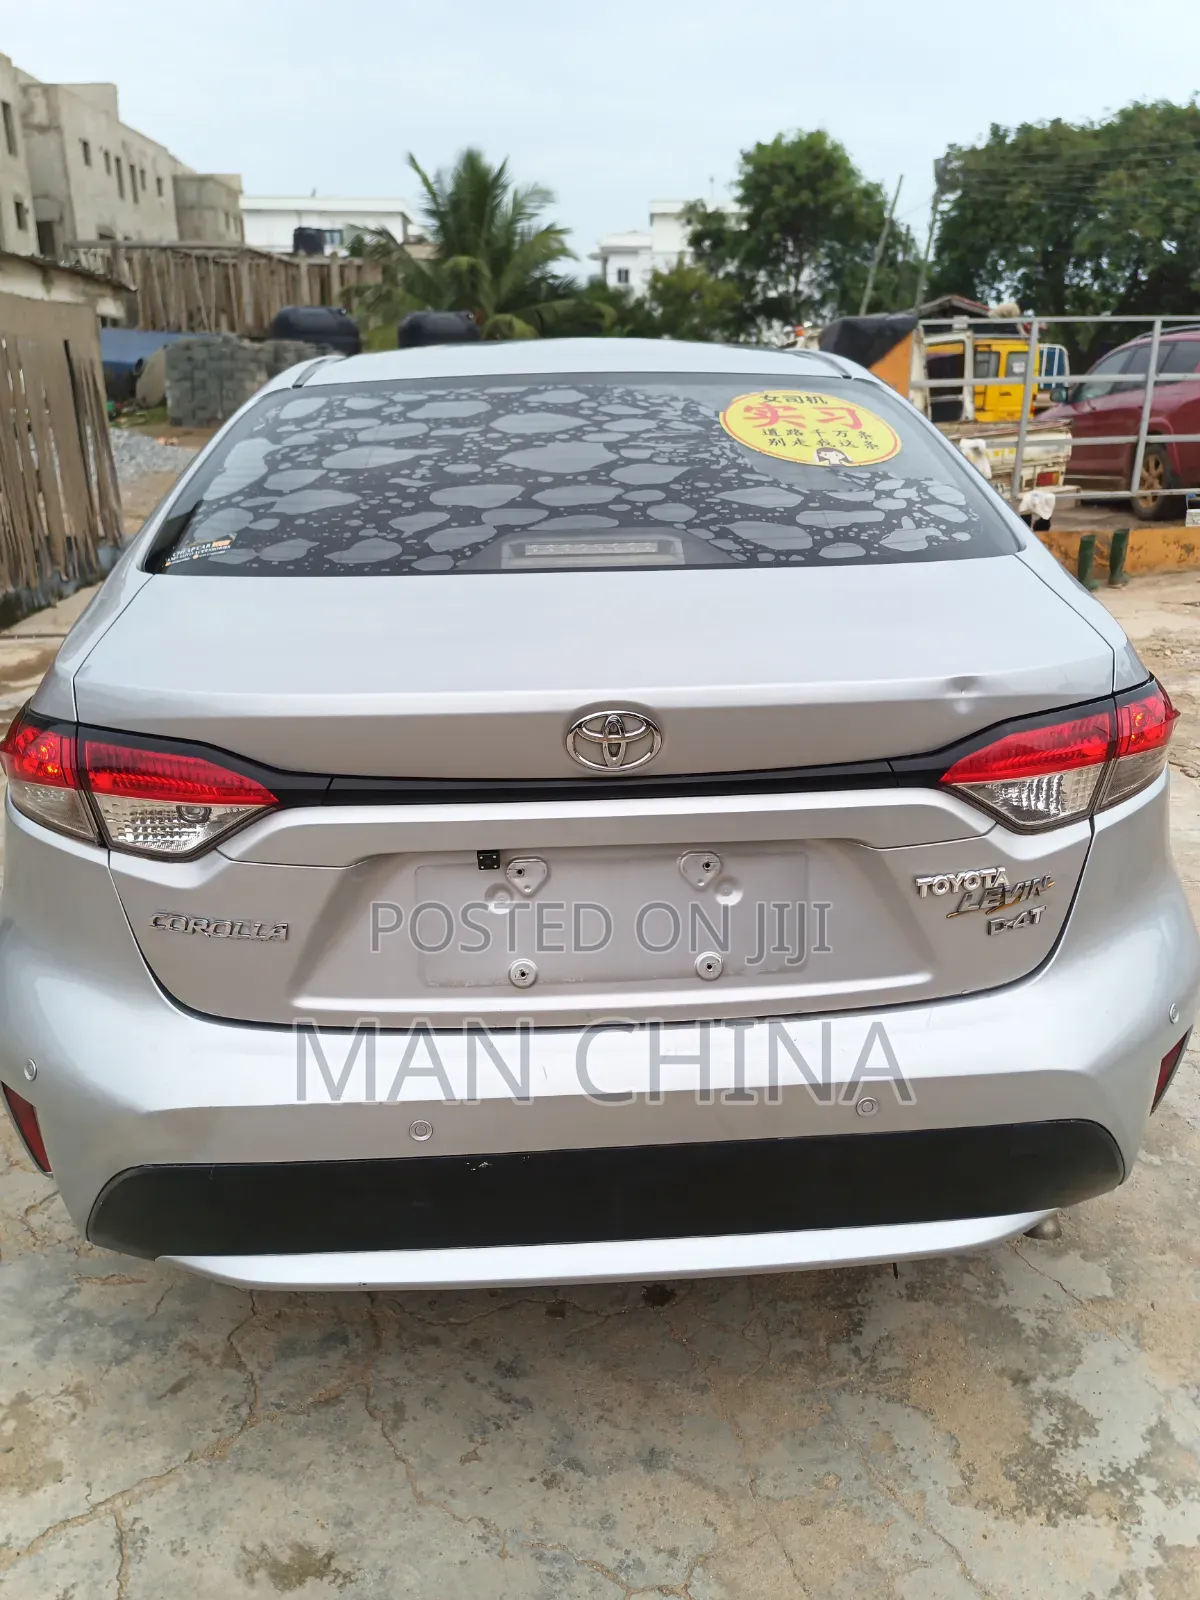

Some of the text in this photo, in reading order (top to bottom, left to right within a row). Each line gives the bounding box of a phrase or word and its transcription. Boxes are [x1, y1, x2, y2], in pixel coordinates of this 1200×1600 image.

[761, 394, 828, 405] 女司机
[743, 403, 863, 430] 实习
[915, 866, 1010, 899] TOYOTA
[150, 911, 289, 941] COROLLA
[987, 905, 1047, 936] D-4T
